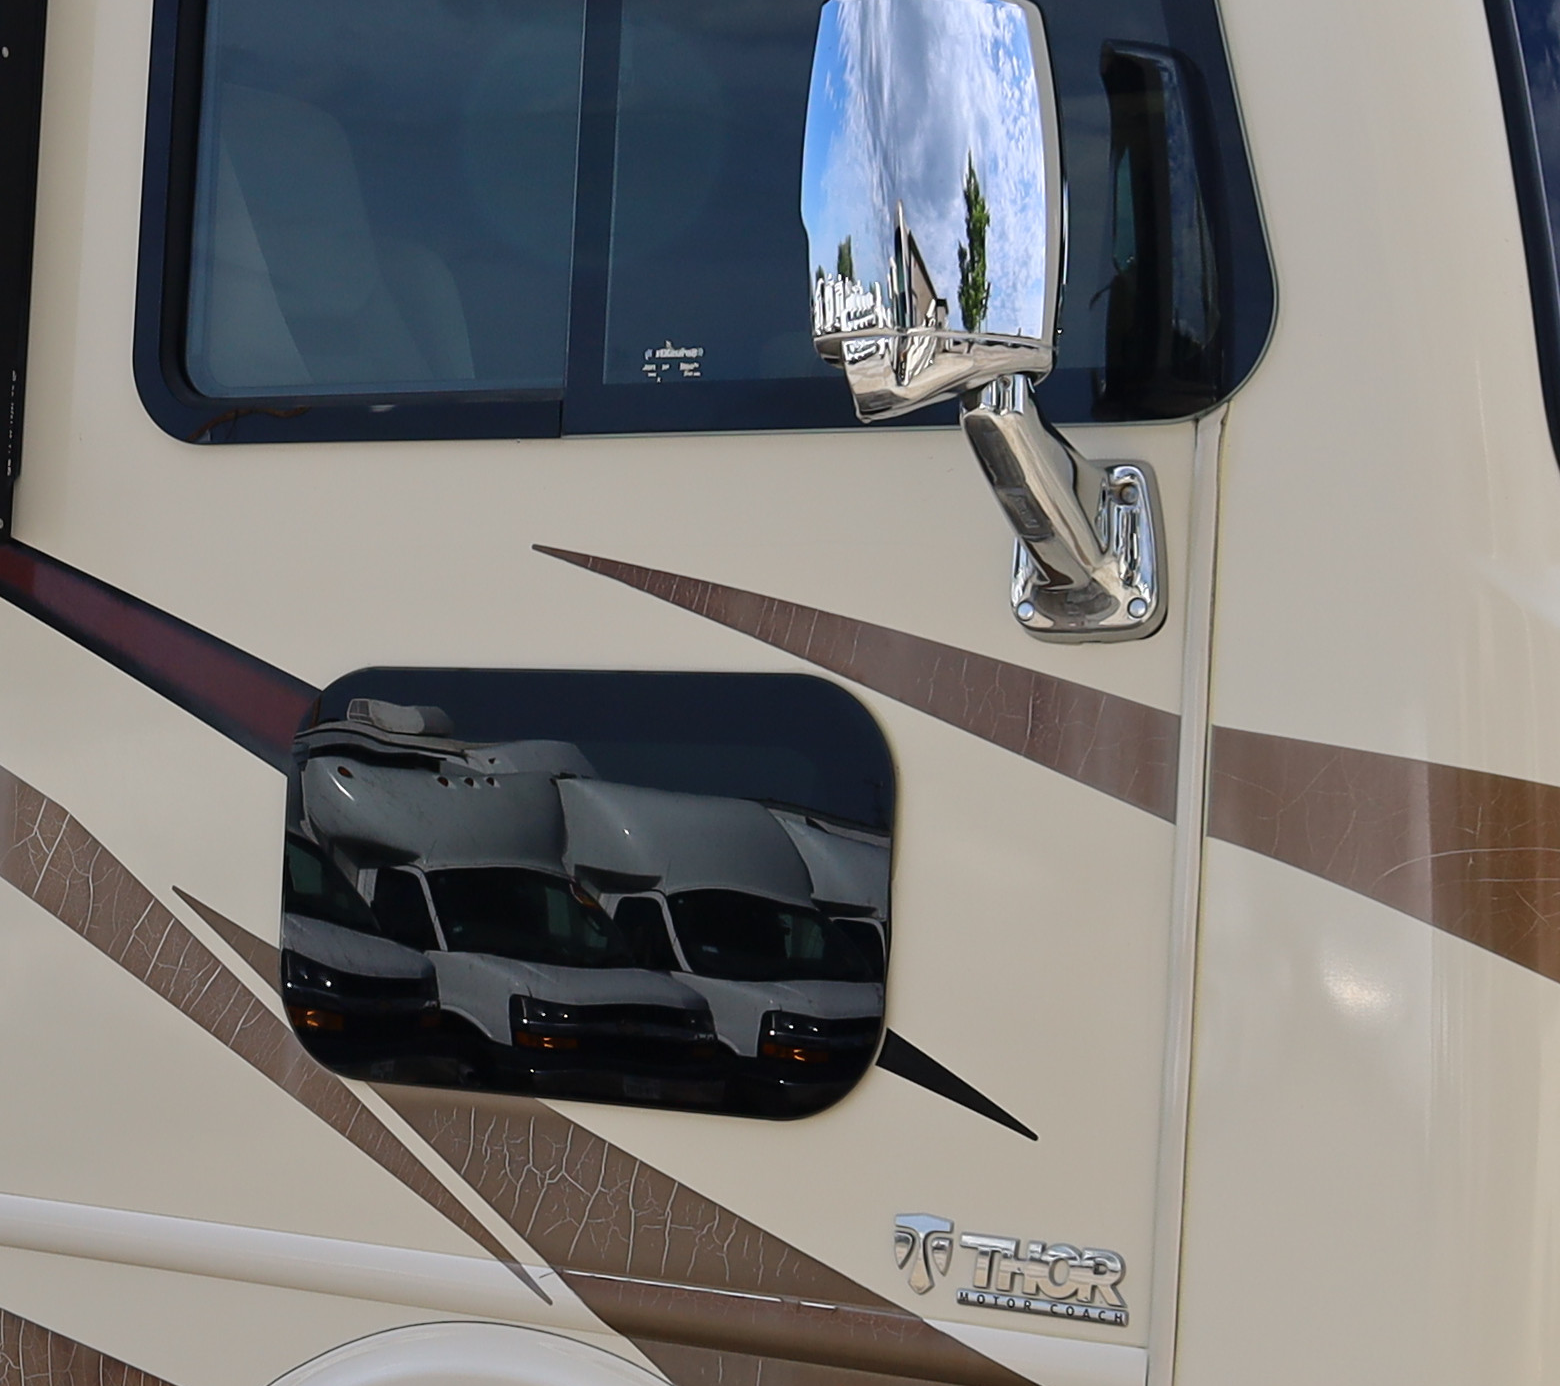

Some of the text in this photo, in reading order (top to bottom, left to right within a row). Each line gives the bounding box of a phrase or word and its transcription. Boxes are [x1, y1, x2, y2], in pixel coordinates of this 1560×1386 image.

[959, 1232, 1127, 1307] THOR
[959, 1291, 1124, 1324] MOTOR COACH
